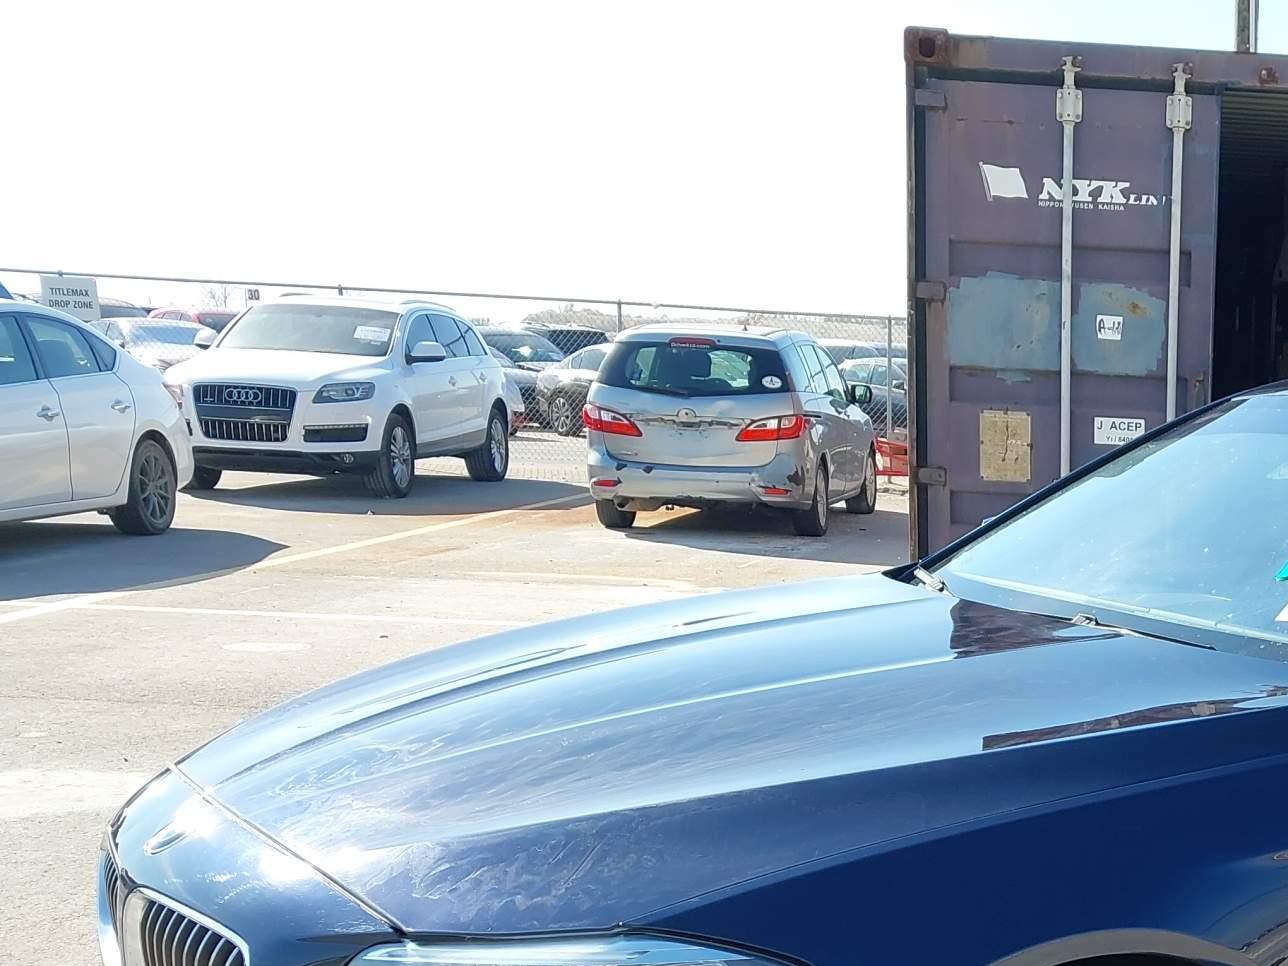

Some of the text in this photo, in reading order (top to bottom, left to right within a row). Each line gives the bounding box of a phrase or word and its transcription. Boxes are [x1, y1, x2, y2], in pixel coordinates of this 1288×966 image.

[1038, 177, 1167, 206] NYK LIN
[49, 287, 90, 297] TITLEMAX
[247, 288, 260, 300] 30
[49, 300, 93, 309] DROP ZONE
[1109, 421, 1142, 432] ACEP
